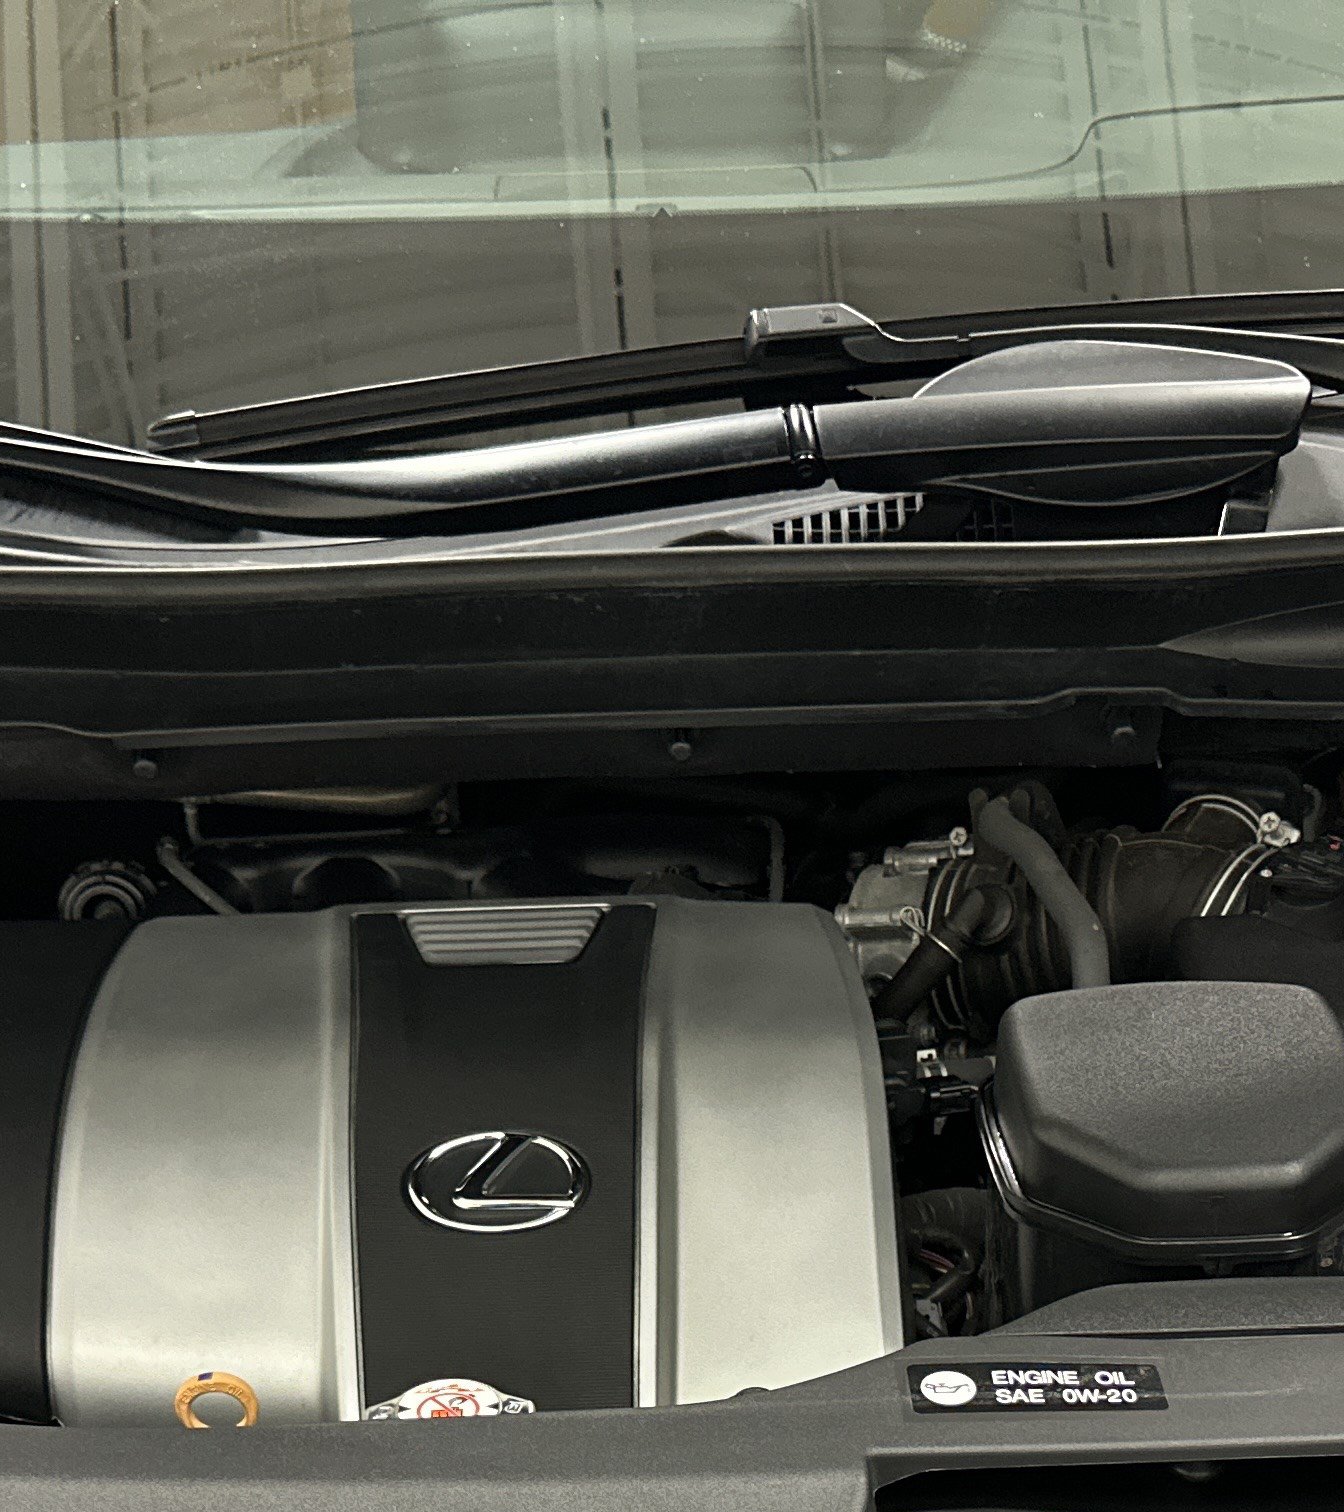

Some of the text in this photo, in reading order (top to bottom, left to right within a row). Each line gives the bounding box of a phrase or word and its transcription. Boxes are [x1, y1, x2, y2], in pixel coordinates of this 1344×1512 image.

[991, 1369, 1135, 1386] ENGINE OIL
[995, 1387, 1138, 1405] SAE 0W-20
